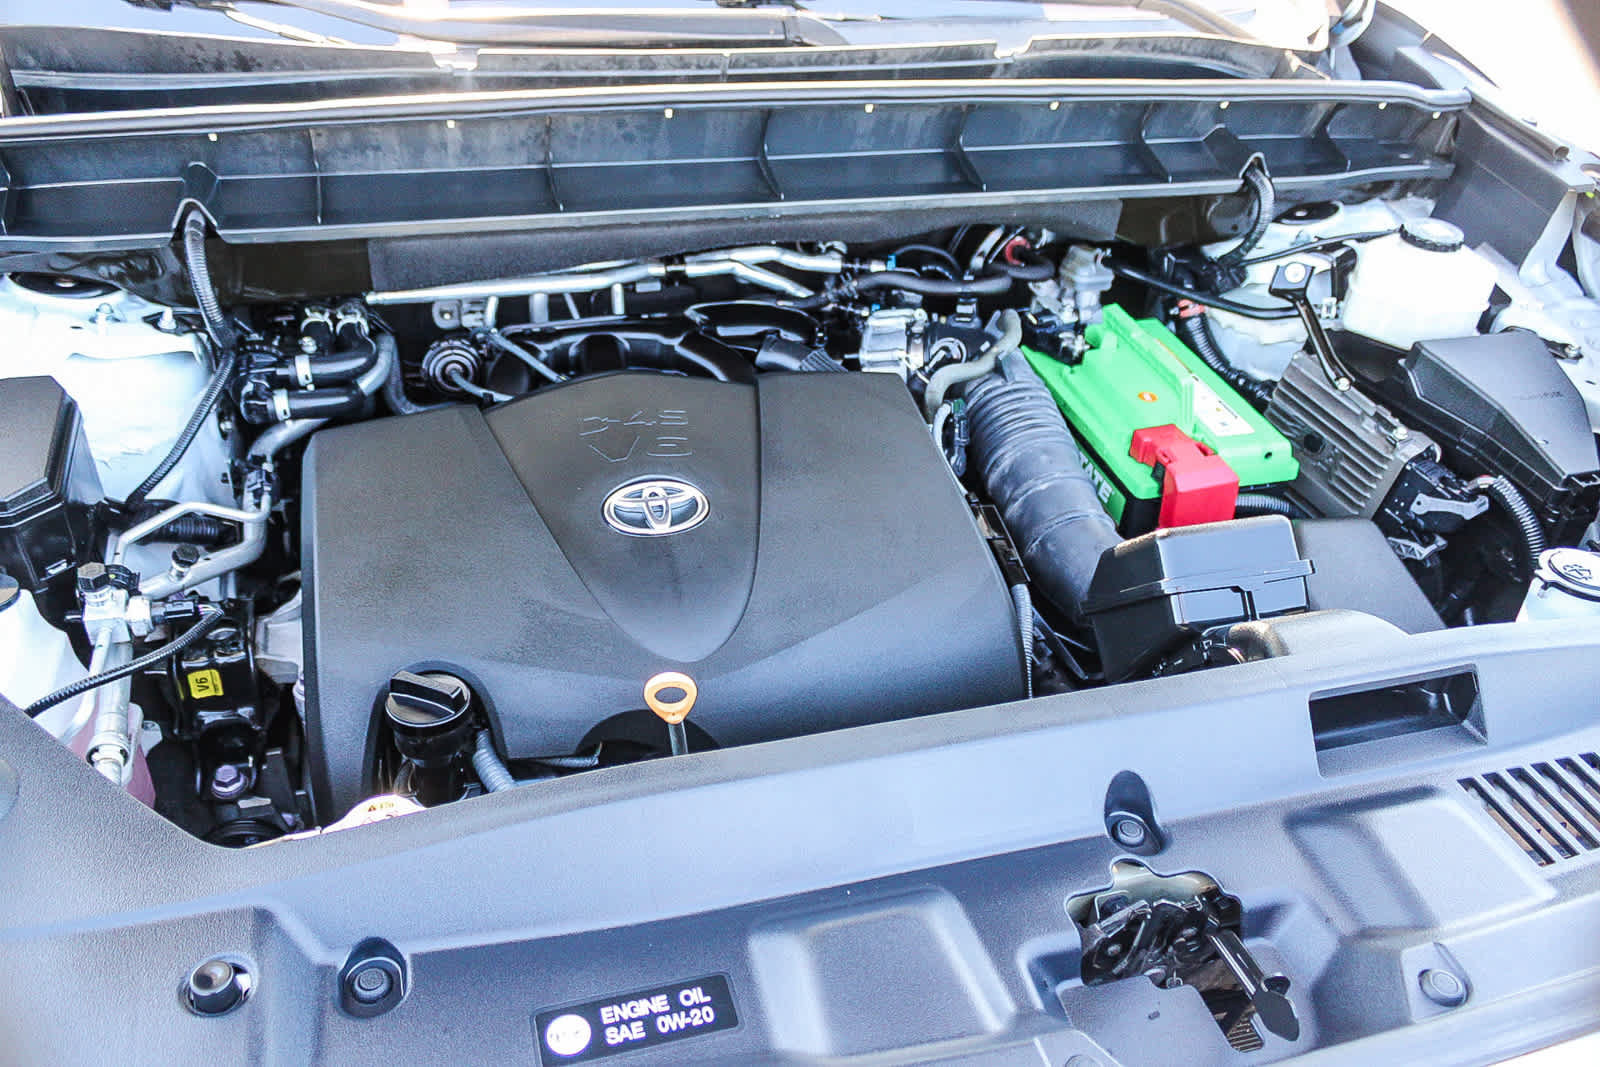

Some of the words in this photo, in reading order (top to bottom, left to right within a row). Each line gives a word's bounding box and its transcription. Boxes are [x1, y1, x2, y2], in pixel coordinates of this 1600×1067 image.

[195, 677, 210, 693] V6
[600, 994, 671, 1025] ENGINE
[679, 986, 712, 1007] OIL
[605, 1020, 647, 1045] SAE
[656, 1005, 715, 1034] 0W-20
